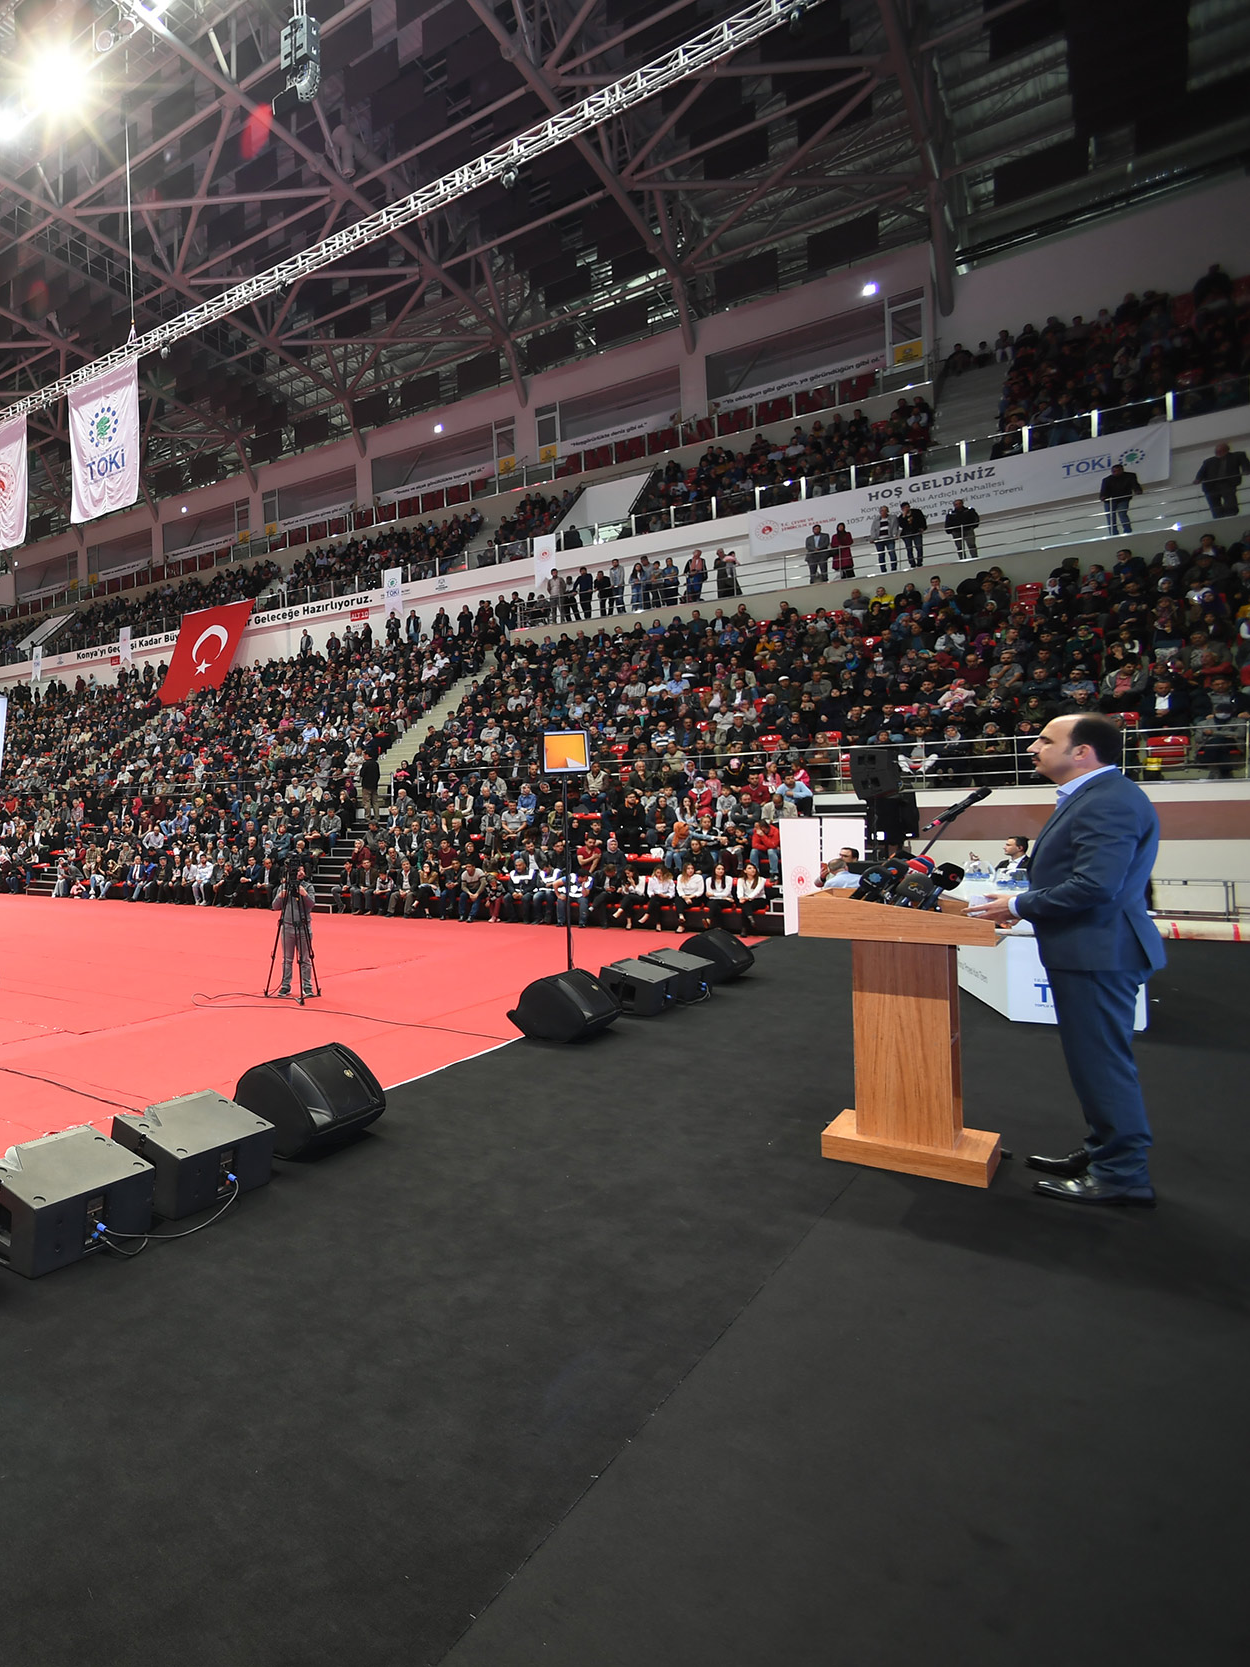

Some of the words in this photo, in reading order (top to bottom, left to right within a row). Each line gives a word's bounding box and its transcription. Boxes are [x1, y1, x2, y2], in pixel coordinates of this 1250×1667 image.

[87, 448, 126, 481] TOKİ
[1062, 455, 1112, 476] TOKİ
[860, 505, 883, 515] Kony
[888, 496, 926, 509] Seluklu
[928, 489, 957, 500] Ardıçlı
[959, 480, 1005, 494] Mahallesi
[868, 486, 903, 502] HOŞ
[908, 466, 996, 493] GELDİNİZ
[846, 515, 865, 525] 1057
[970, 492, 991, 501] Kura
[993, 485, 1024, 495] Töreni
[254, 608, 300, 625] Geleceğe
[302, 594, 373, 616] Hazırlıyoruz.
[76, 647, 107, 660] Konya'yı
[107, 642, 137, 656] Geçşi
[138, 636, 161, 649] Kadar
[164, 633, 179, 643] Büy
